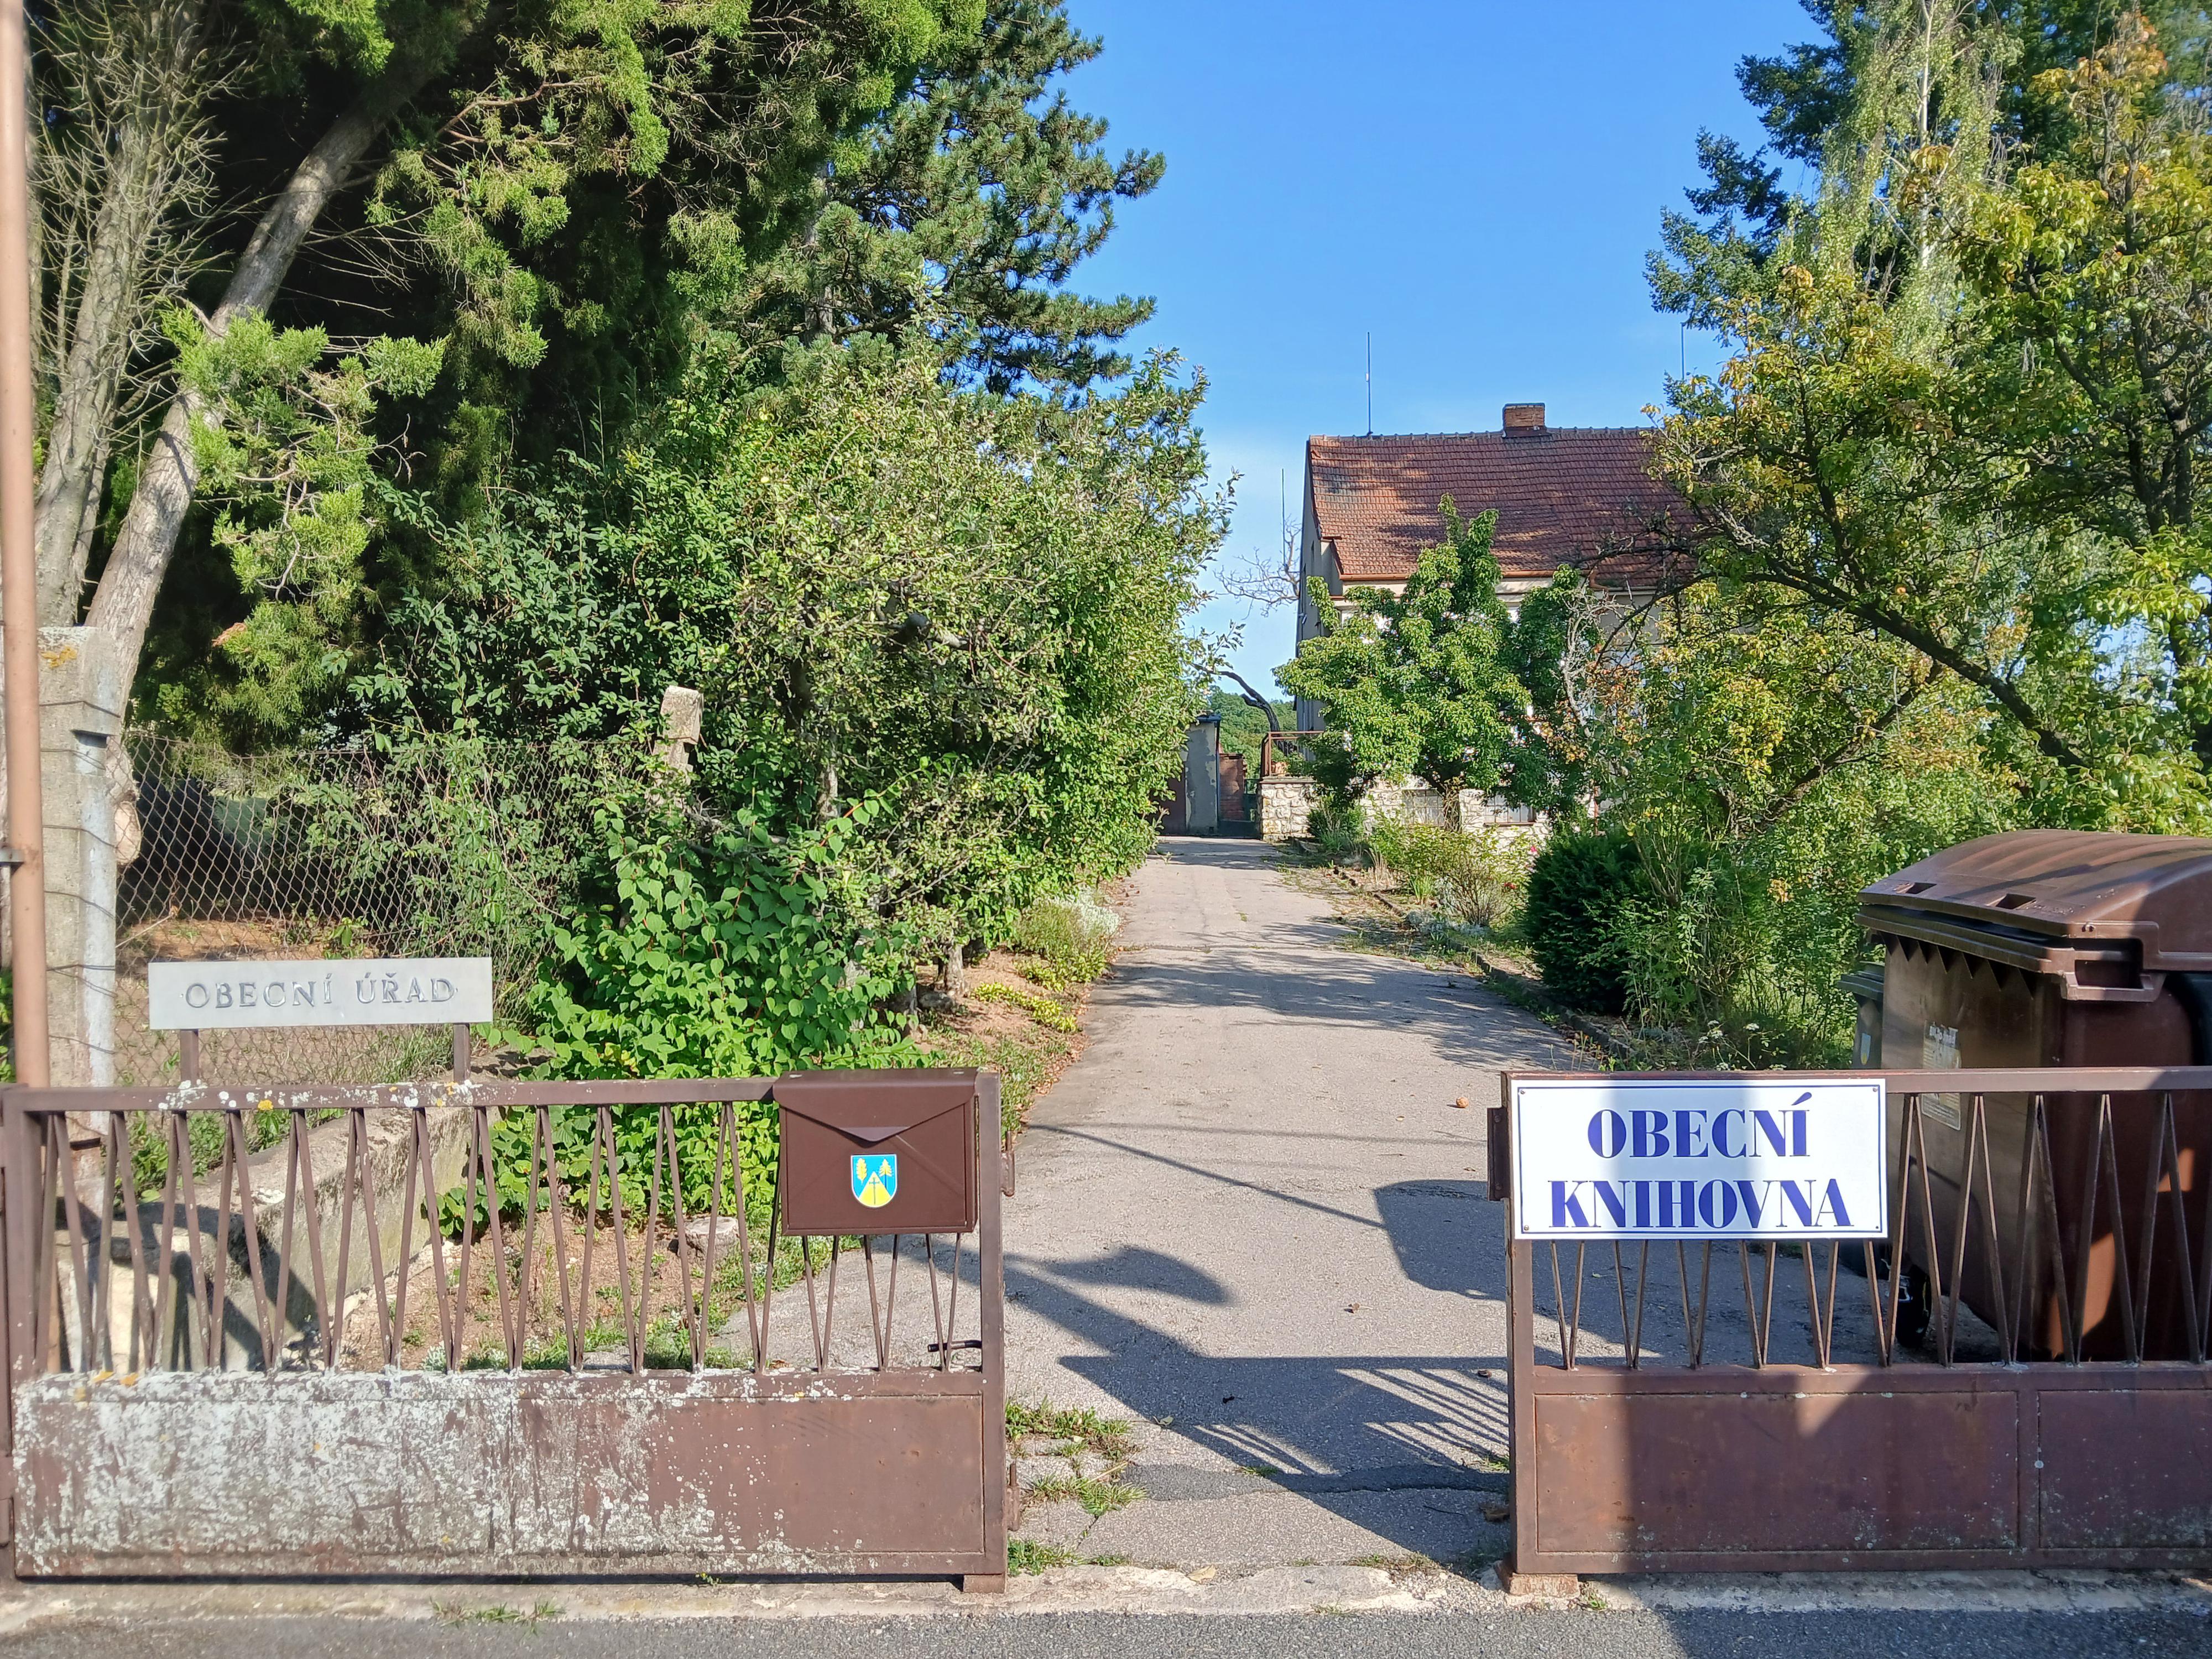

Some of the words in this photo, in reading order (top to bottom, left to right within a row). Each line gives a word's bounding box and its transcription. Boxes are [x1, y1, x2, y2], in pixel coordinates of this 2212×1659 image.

[185, 973, 332, 1008] OBECNÍ
[356, 972, 455, 1004] ÚŘAD
[1587, 1092, 1812, 1159] OBECNÍ
[1548, 1178, 1855, 1229] KNIHOVNA
